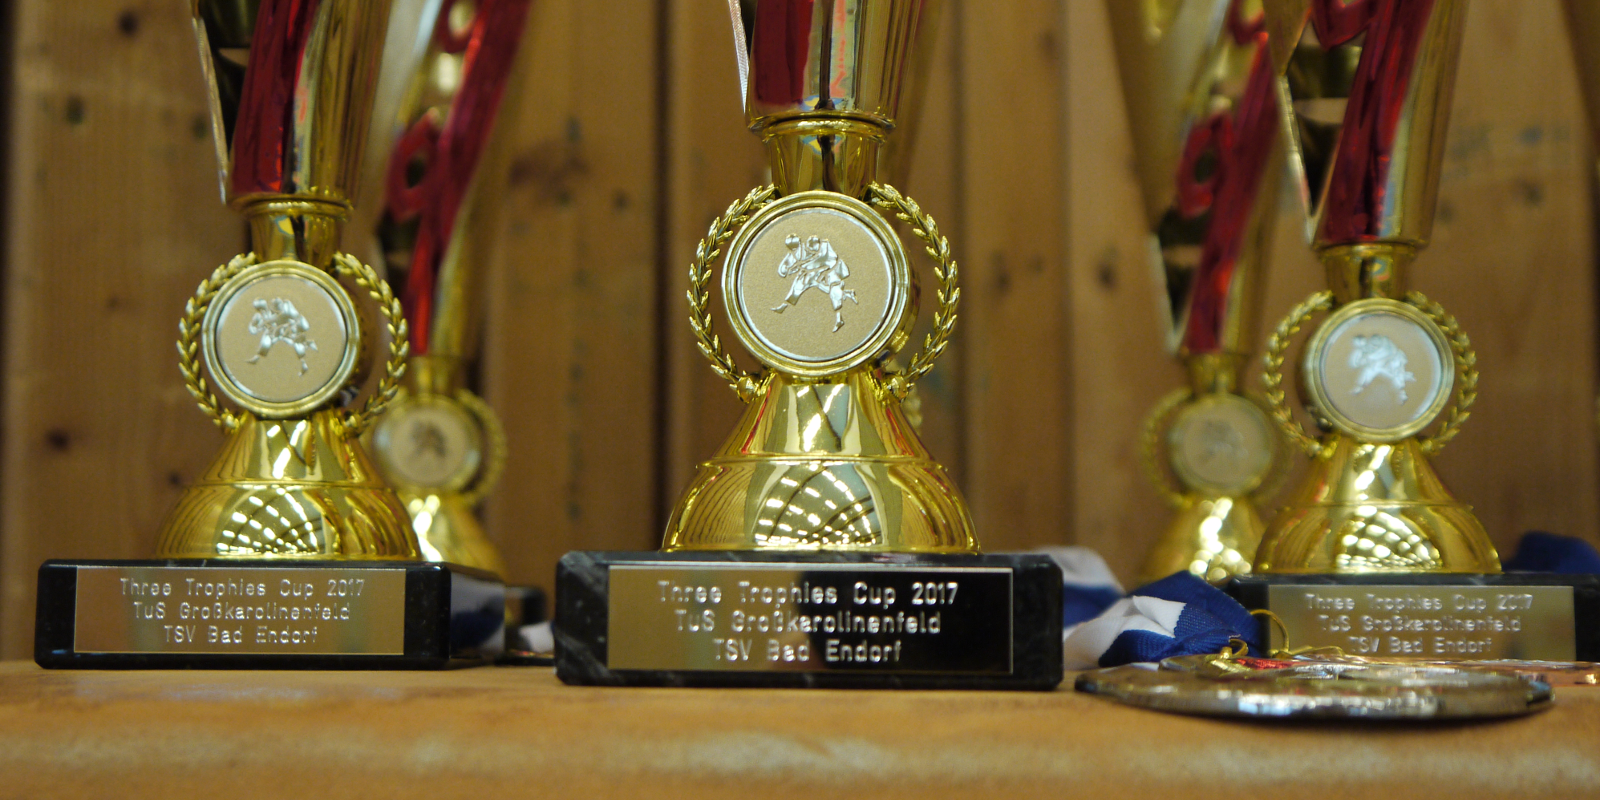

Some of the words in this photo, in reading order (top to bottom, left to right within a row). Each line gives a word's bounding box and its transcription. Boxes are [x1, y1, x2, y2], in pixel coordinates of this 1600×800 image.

[120, 578, 172, 596] Three
[185, 578, 267, 600] Trophies
[279, 578, 315, 600] Cup
[326, 578, 366, 597] 2017
[658, 580, 722, 603] Three
[738, 580, 838, 609] Trophies
[852, 580, 897, 610] Cup
[911, 581, 959, 605] 2017
[133, 601, 166, 619] TuS
[179, 601, 351, 621] Großkarolinenfeld
[674, 609, 716, 633] TuS
[730, 609, 942, 634] Großkarolinenfeld
[164, 625, 196, 643] TSV
[207, 625, 243, 643] Bad
[255, 625, 318, 644] Endorf
[712, 638, 753, 661] TSV
[766, 638, 811, 662] Bad
[825, 638, 903, 663] Endorf
